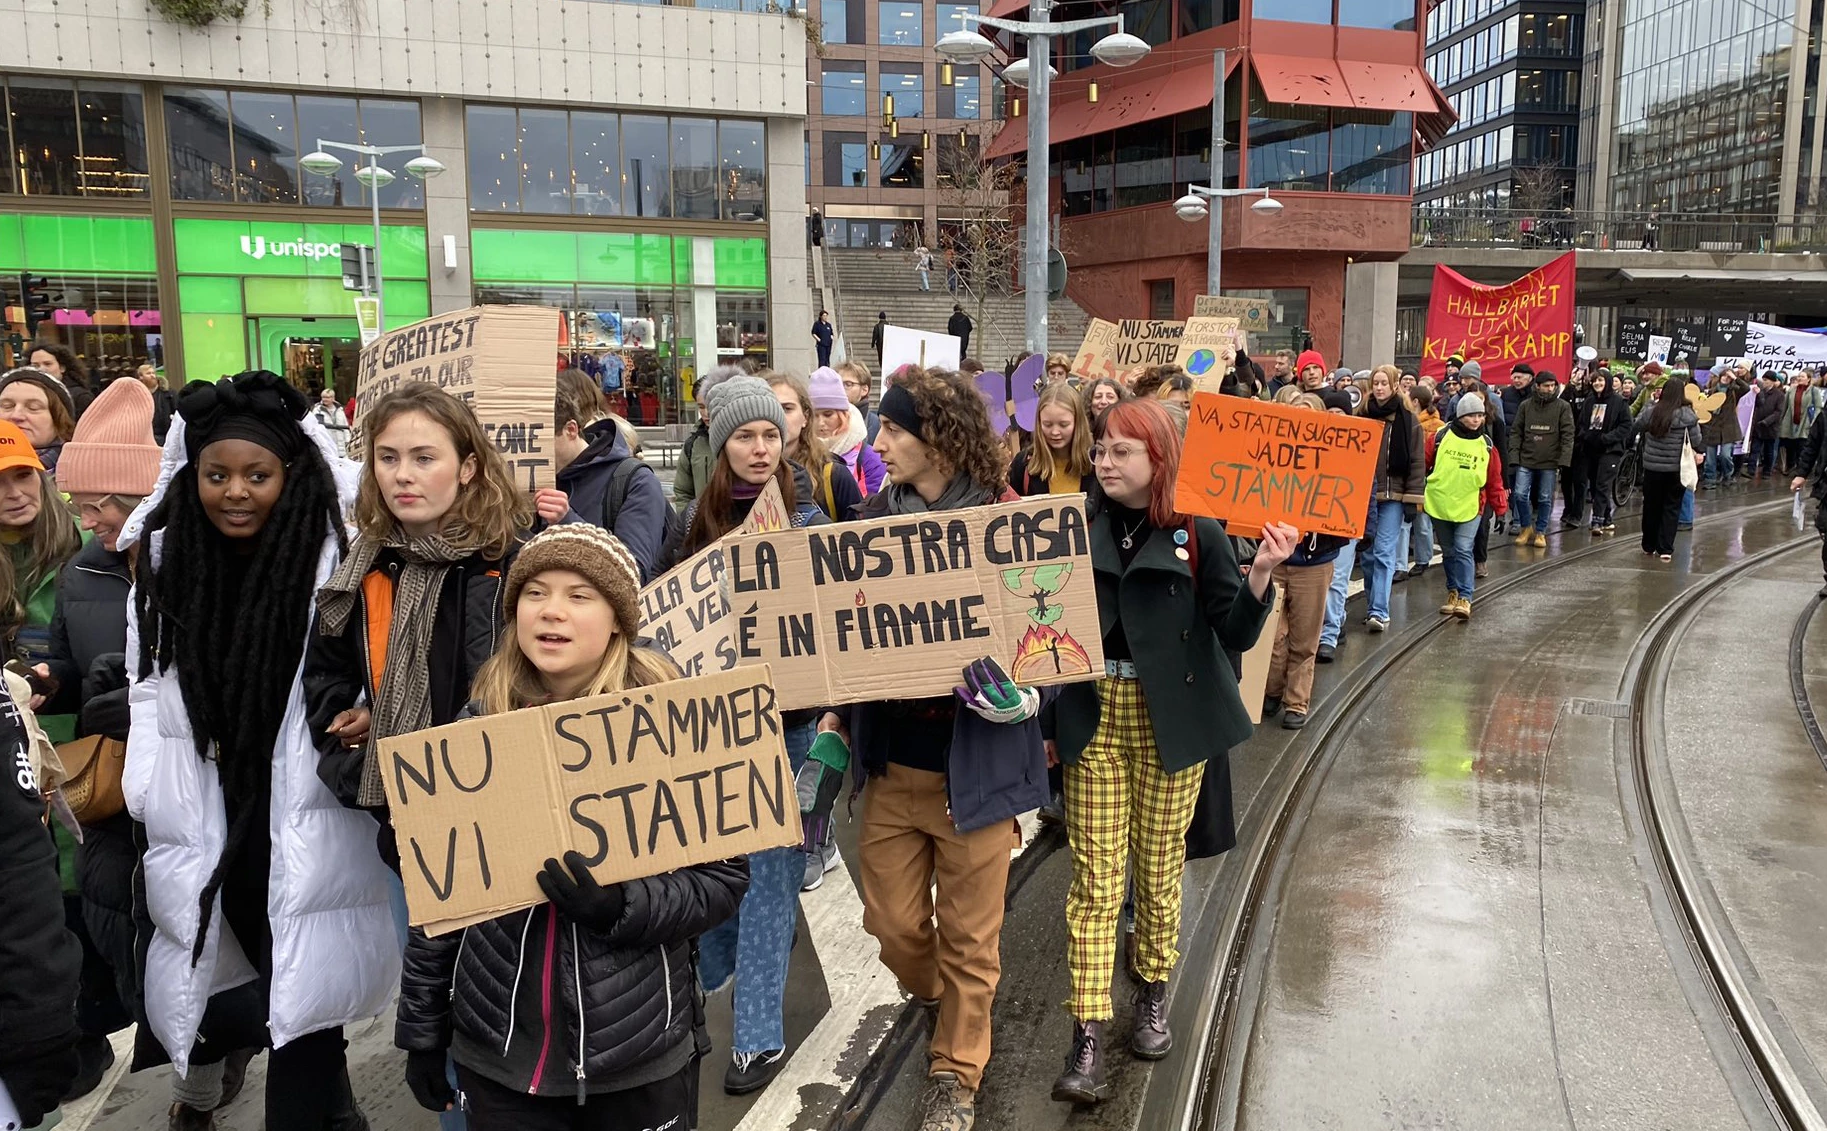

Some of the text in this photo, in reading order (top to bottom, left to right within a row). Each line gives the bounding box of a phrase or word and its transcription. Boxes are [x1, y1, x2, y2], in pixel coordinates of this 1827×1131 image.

[1119, 320, 1140, 340] NU
[1423, 332, 1571, 361] KLASSKAMP
[1622, 332, 1645, 341] SELMA
[359, 315, 480, 386] THE GREATEST
[1116, 342, 1132, 365] VI
[1785, 345, 1796, 357] &
[1196, 404, 1373, 454] VA, STATEN SUGER?
[1277, 442, 1329, 470] DET
[731, 506, 1088, 594] LA NOSTRA CASA
[740, 594, 991, 659] É IN FIAMME
[393, 683, 780, 806] NU STÄMMER
[410, 754, 786, 902] VI STATEN
